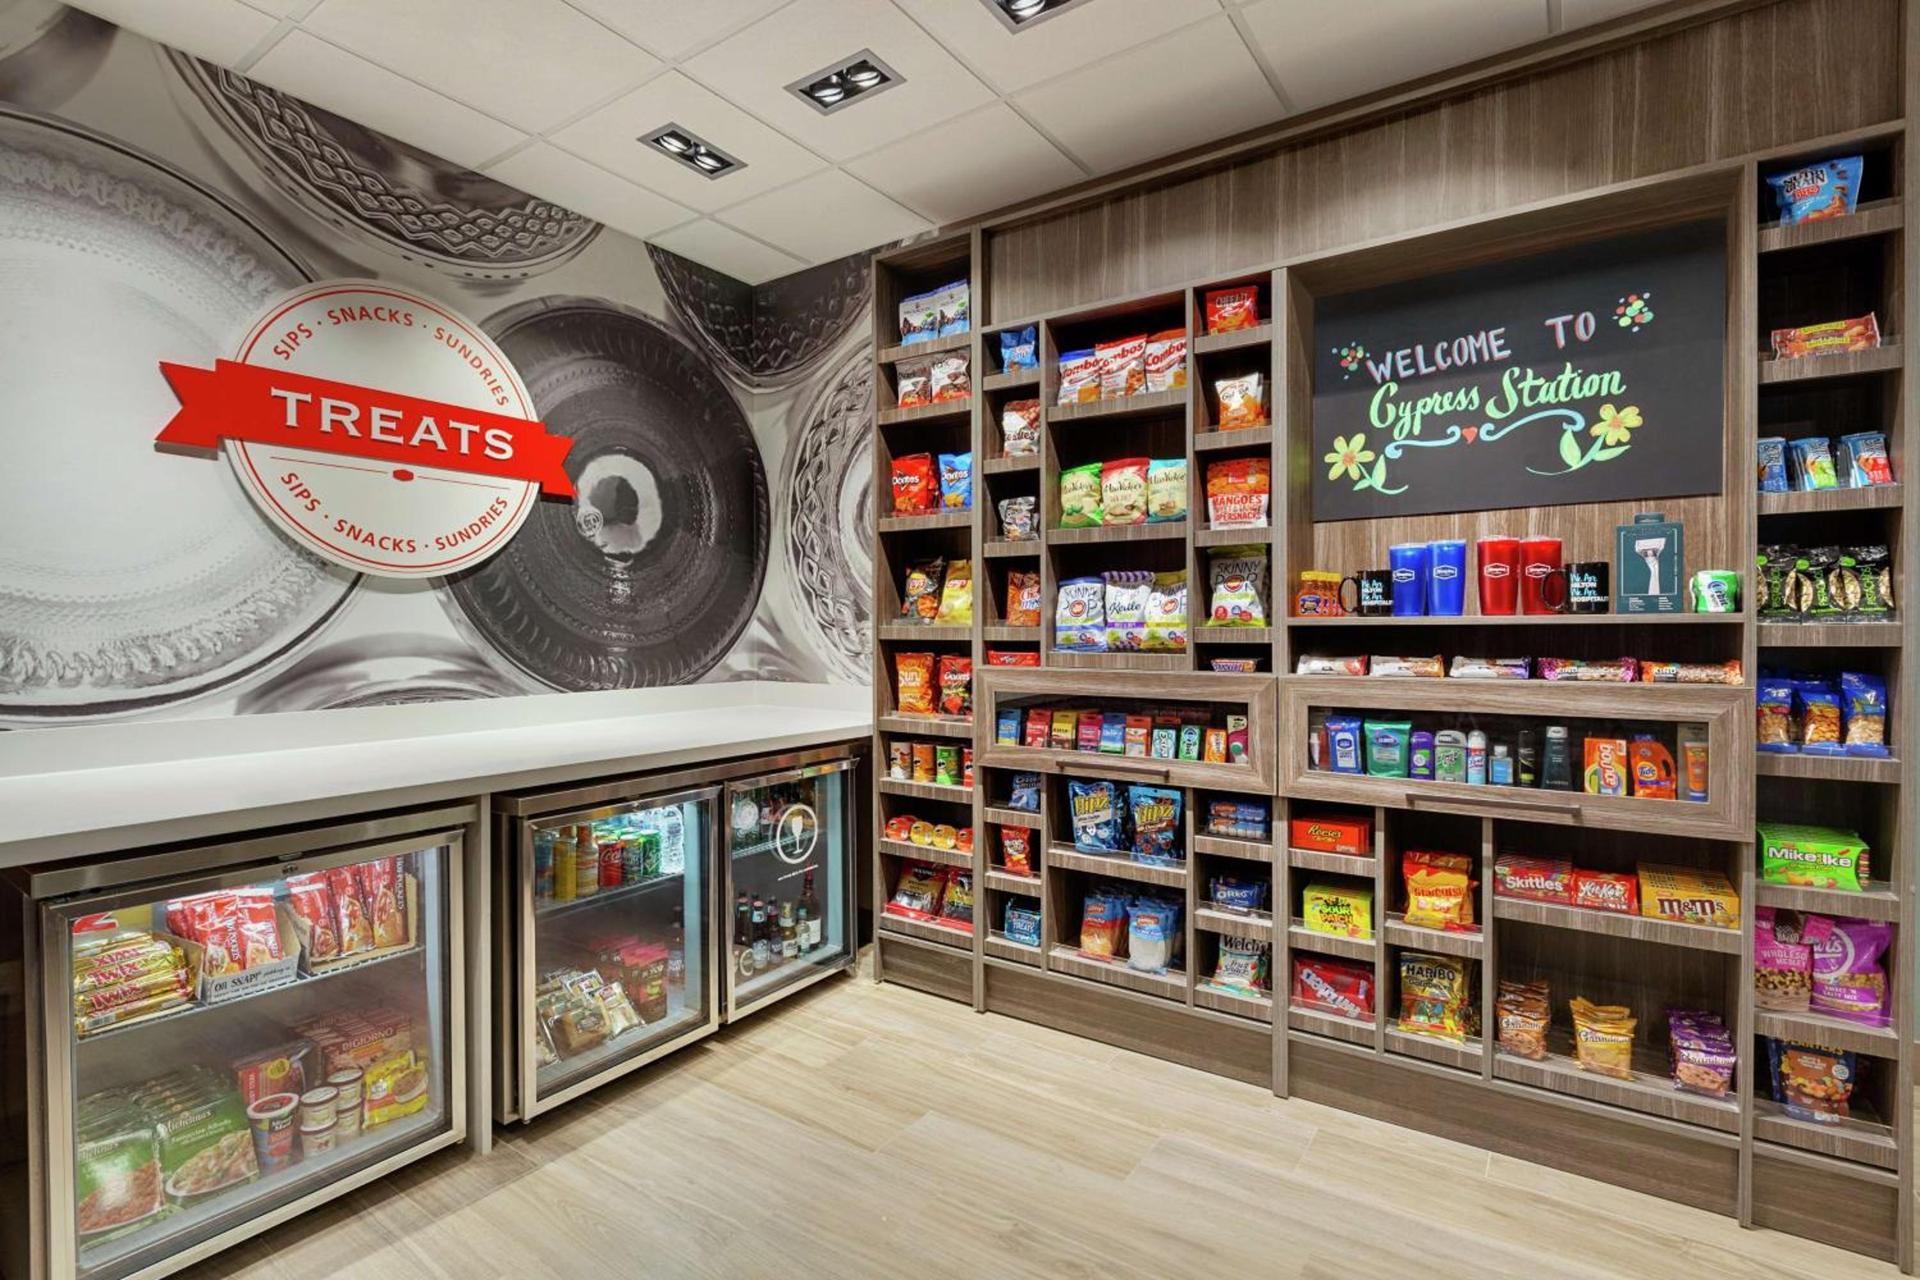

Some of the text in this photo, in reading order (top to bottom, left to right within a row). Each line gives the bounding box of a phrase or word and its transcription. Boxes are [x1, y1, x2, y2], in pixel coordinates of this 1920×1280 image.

[272, 305, 510, 408] SIPS SNACKS SUNDRIES
[1364, 311, 1597, 385] WELCOME TO
[1369, 361, 1627, 441] Cypress Station
[270, 386, 515, 462] TREATS
[891, 475, 920, 486] Doritos
[280, 470, 509, 554] SIPS SNACKS SUNDRIES
[1638, 765, 1657, 778] Tide
[1768, 847, 1815, 862] Mike
[1823, 854, 1853, 868] Ike
[1506, 876, 1564, 893] Skittles
[1405, 963, 1456, 983] HARIBO
[342, 1026, 394, 1051] DIGIORNO
